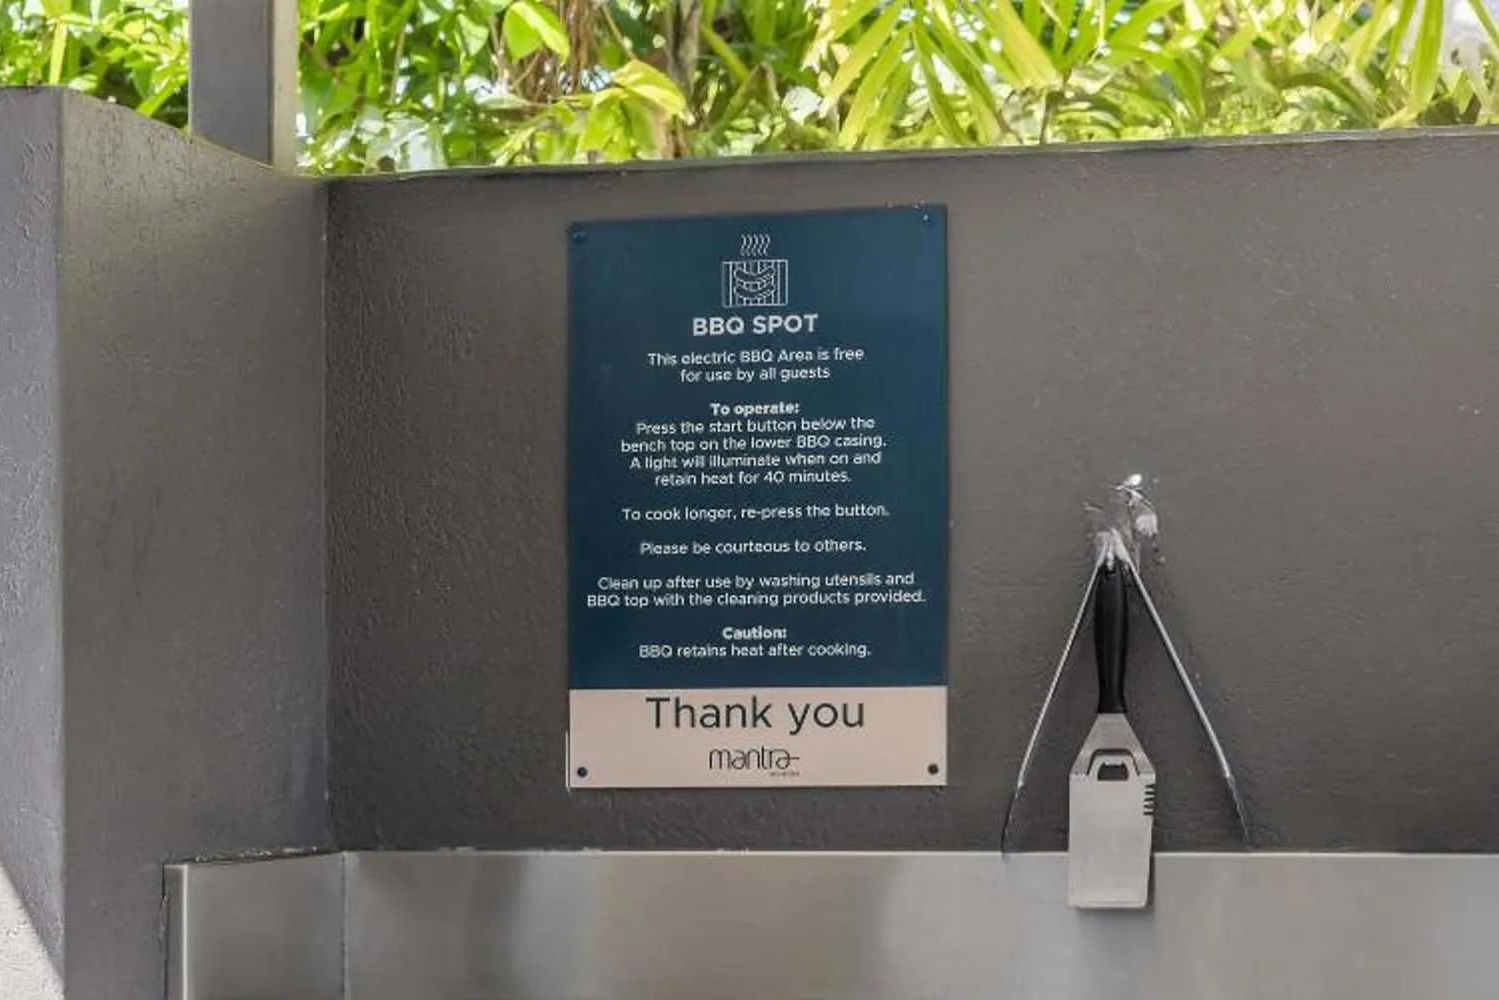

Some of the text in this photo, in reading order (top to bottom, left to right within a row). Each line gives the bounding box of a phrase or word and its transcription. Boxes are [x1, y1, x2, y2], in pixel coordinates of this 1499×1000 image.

[692, 313, 818, 337] BBQ SPOT
[647, 347, 865, 366] This electric BBQ Area is free
[680, 366, 831, 383] for use by all guests
[710, 402, 800, 417] To operate:
[636, 416, 875, 434] Press the start button below the
[621, 433, 887, 453] bench top on the lower BBQ casing.
[629, 451, 882, 471] A light will illuminate when on and
[654, 469, 852, 486] retain heat for 40 minutes.
[622, 504, 891, 522] To cook longer, re-press the button.
[640, 538, 867, 555] Please be courteous to others.
[597, 572, 915, 592] Clean up after use by washing utensils and
[587, 588, 927, 608] BBQ top with the cleaning products provided.
[722, 625, 787, 640] Caution:
[639, 642, 872, 659] BBQ retains heat after cooking.
[646, 696, 864, 736] Thank you
[709, 746, 800, 771] mantra
